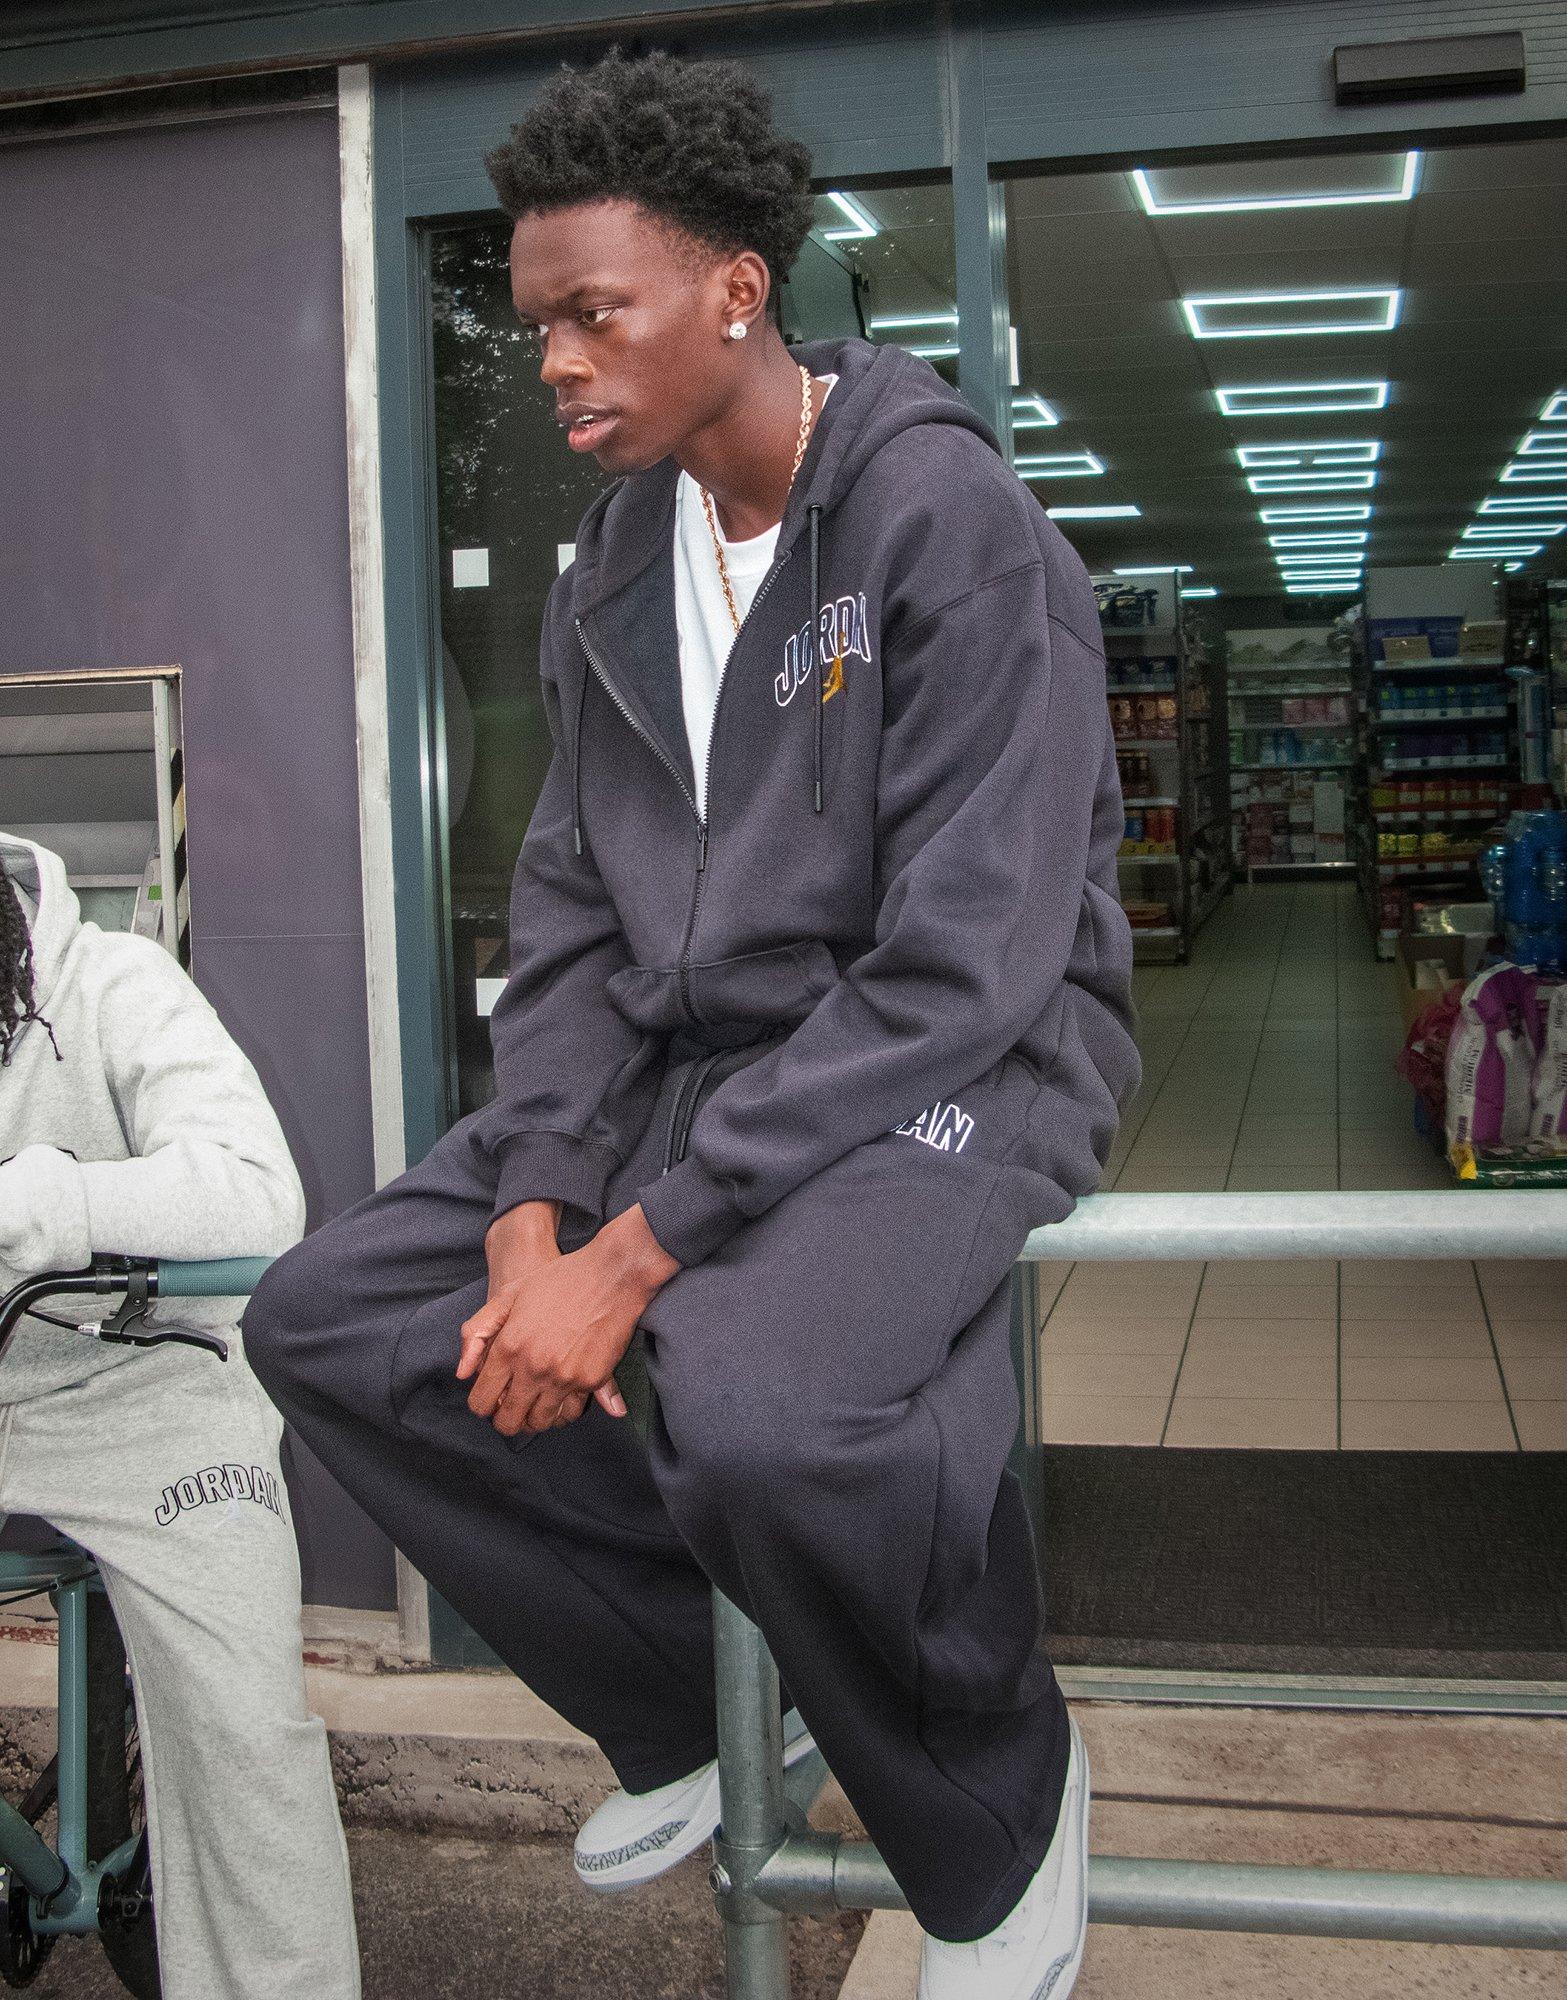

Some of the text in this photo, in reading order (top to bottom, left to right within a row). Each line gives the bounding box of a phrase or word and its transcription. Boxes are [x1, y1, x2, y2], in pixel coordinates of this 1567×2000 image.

[1464, 1049, 1480, 1094] MEDIUM
[891, 1101, 975, 1153] AN
[155, 1463, 286, 1526] JORDAN
